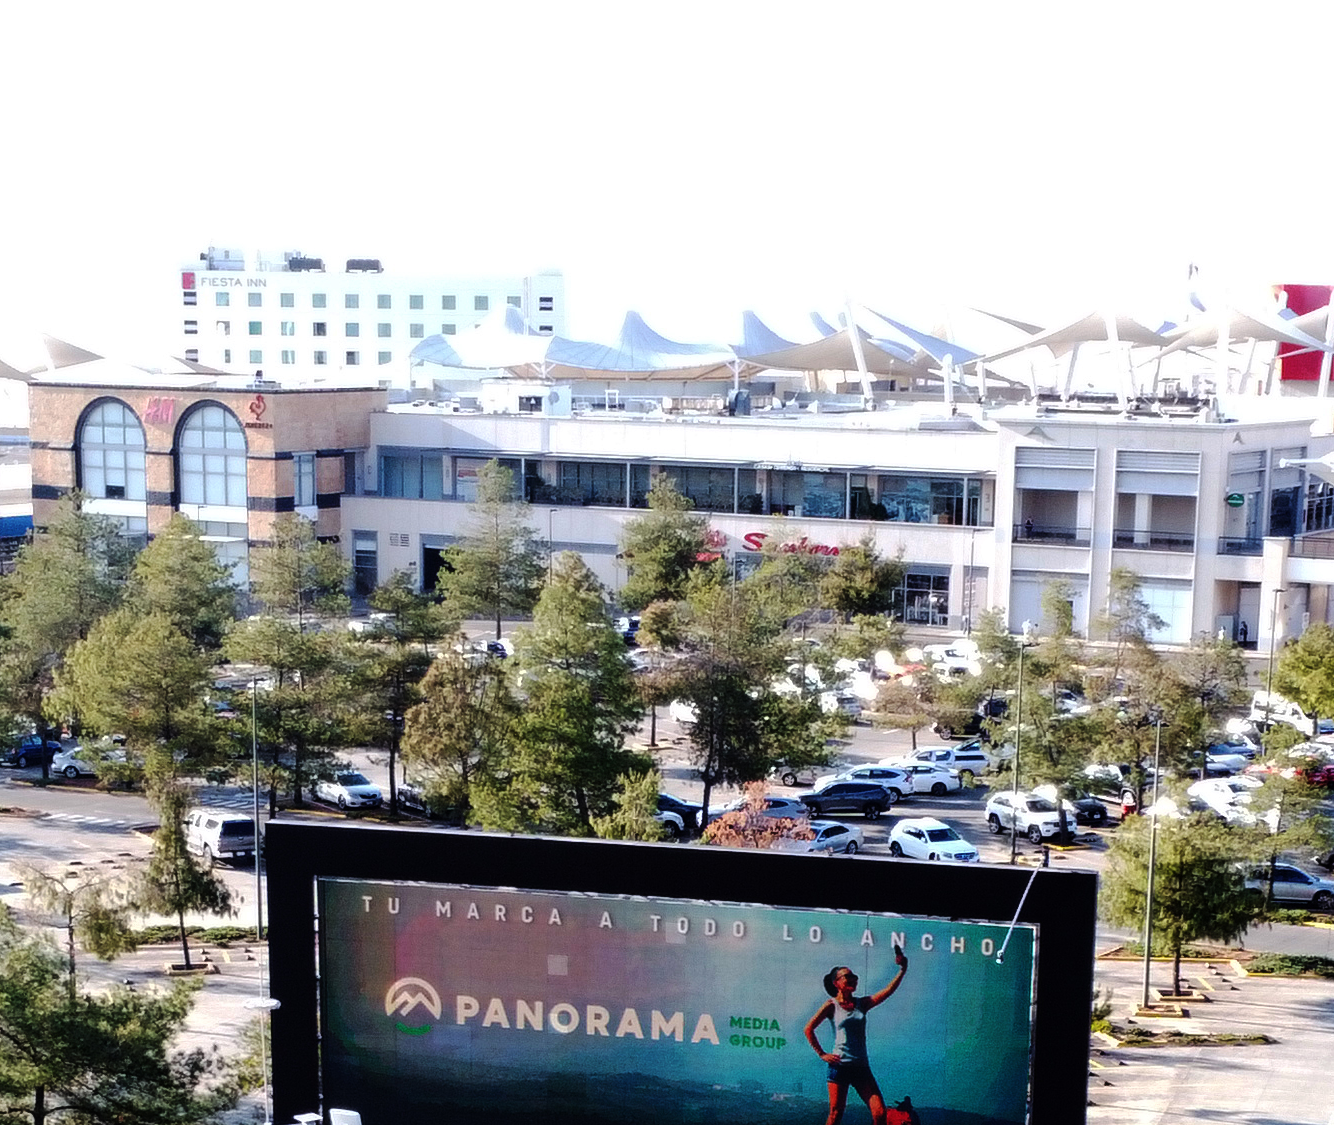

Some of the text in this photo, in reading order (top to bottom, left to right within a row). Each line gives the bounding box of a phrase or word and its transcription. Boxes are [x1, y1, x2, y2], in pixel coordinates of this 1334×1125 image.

[200, 277, 267, 288] FIESTA INN
[362, 895, 995, 957] TU MARCA A TODO LO ANCHO
[456, 994, 720, 1046] PANORAMA
[729, 1015, 781, 1032] MEDIA
[728, 1034, 787, 1050] GROUP
